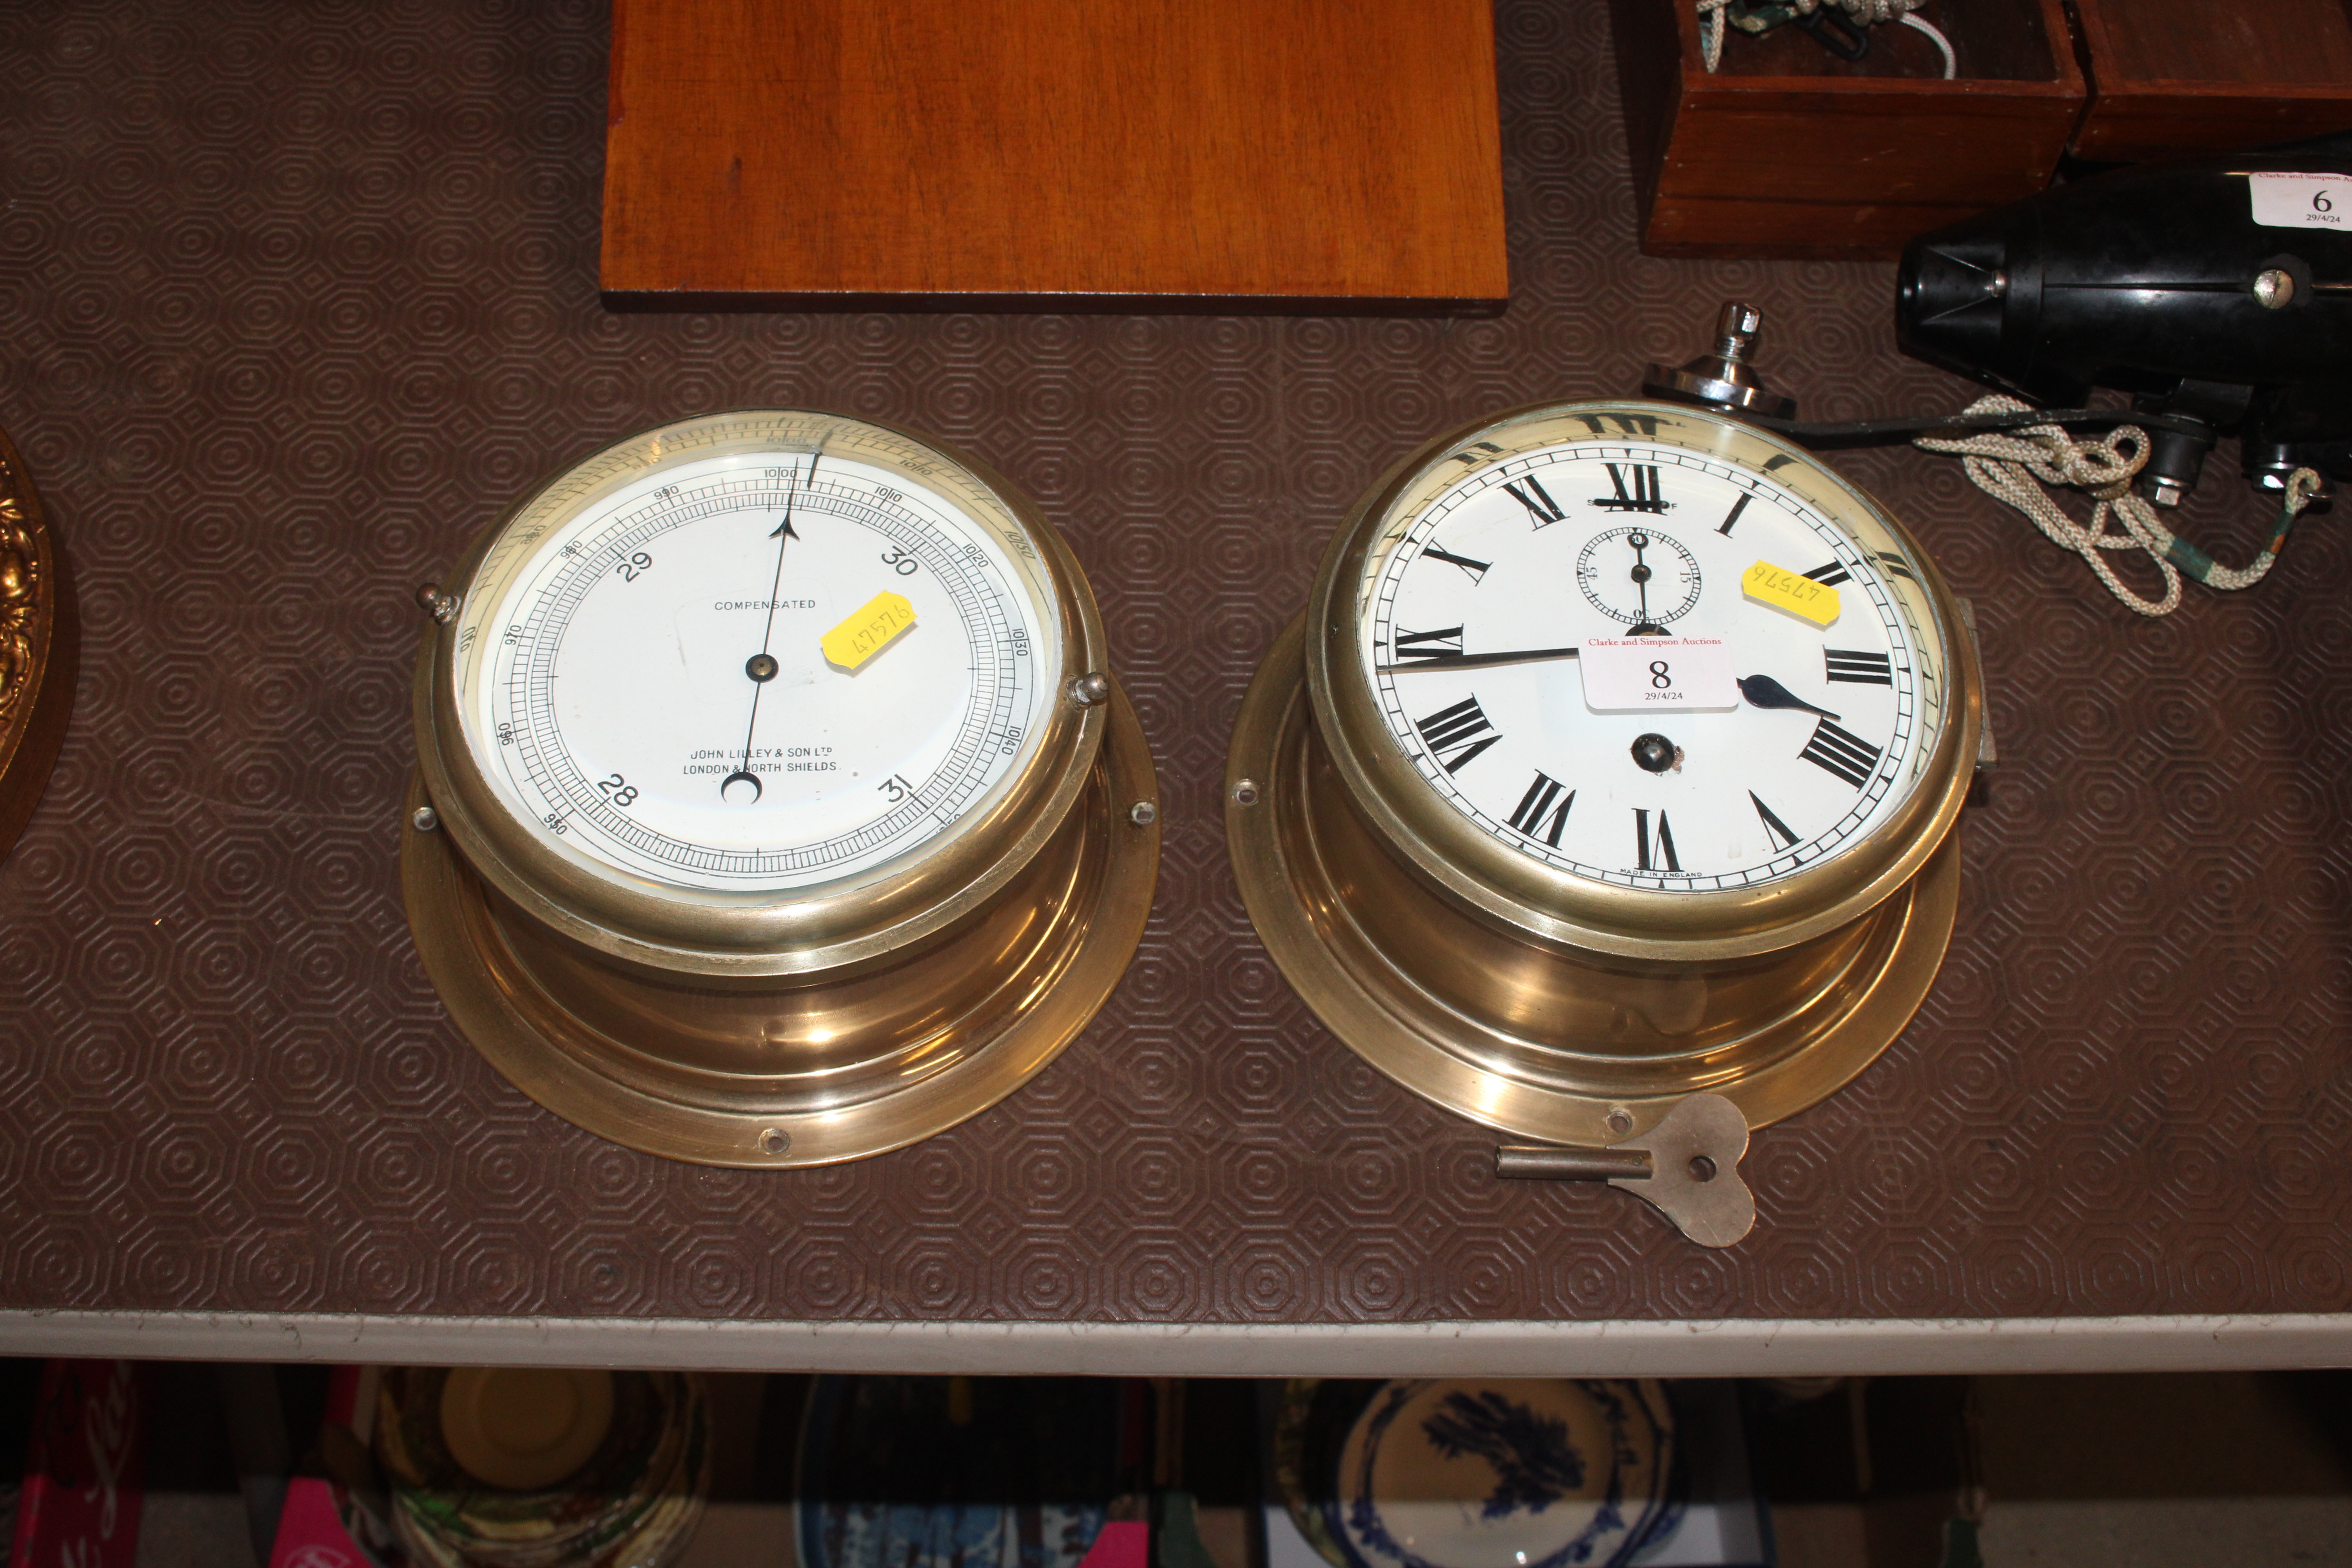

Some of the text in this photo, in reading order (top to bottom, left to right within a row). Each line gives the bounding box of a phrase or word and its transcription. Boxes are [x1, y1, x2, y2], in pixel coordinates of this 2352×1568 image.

[2313, 190, 2332, 212] 6
[2306, 214, 2341, 223] 29/4/24
[765, 469, 797, 478] 1000
[654, 486, 679, 500] 990
[875, 486, 903, 503] 1010
[1496, 474, 1571, 531] XI
[1600, 463, 1668, 516] XII
[1713, 490, 1757, 539] I
[560, 540, 583, 559] 980
[881, 545, 918, 577] 30
[963, 543, 989, 568] 1020
[1418, 536, 1494, 587] X
[617, 552, 652, 583] 29
[1586, 567, 1598, 581] 45
[1679, 571, 1692, 583] 15
[1754, 566, 1820, 601] 47576
[715, 600, 816, 611] COMPENSATED
[505, 625, 522, 645] 970
[852, 604, 909, 654] 47576
[1012, 628, 1028, 656] 1030
[1395, 622, 1464, 662] IX
[1588, 638, 1619, 646] Clarke
[1640, 638, 1679, 647] Simpson
[1649, 661, 1671, 689] 8
[1823, 644, 1892, 689] III
[498, 722, 514, 746] 960
[1002, 726, 1022, 755] 1040
[1414, 692, 1503, 780] VIII
[691, 750, 724, 759] JOHN
[730, 749, 772, 759] LILLEY
[775, 748, 783, 757] &
[788, 748, 811, 757] SON
[1797, 715, 1884, 793] IIII
[683, 764, 729, 775] LONDON
[732, 764, 741, 773] &
[745, 763, 781, 772] NORTH
[597, 773, 639, 807] 28
[878, 773, 913, 803] 31
[1502, 768, 1576, 851] VII
[1748, 789, 1804, 855] V
[544, 813, 568, 835] 950
[1631, 808, 1685, 872] VI
